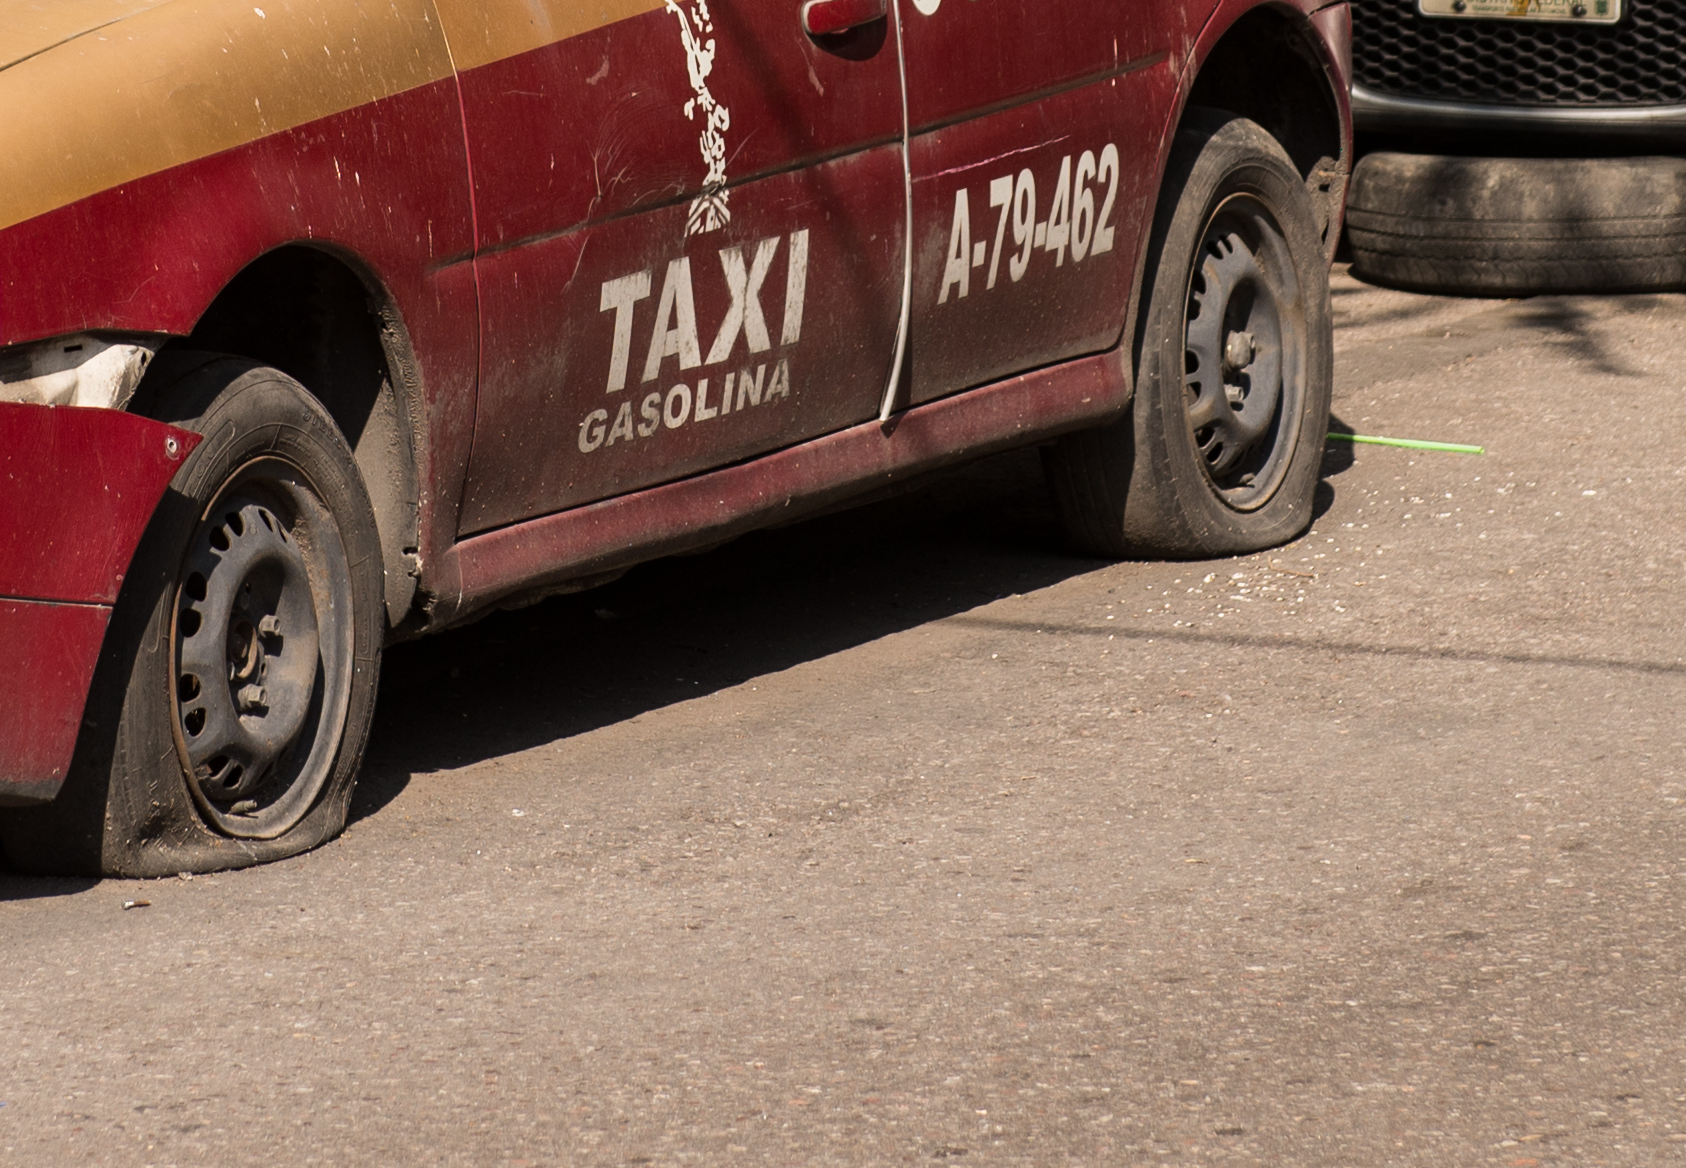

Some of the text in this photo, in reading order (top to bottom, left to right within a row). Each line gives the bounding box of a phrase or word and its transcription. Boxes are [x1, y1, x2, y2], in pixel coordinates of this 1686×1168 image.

[936, 142, 1120, 306] A-79-462
[599, 228, 811, 394] TAXI
[577, 358, 792, 454] GASOLINA
